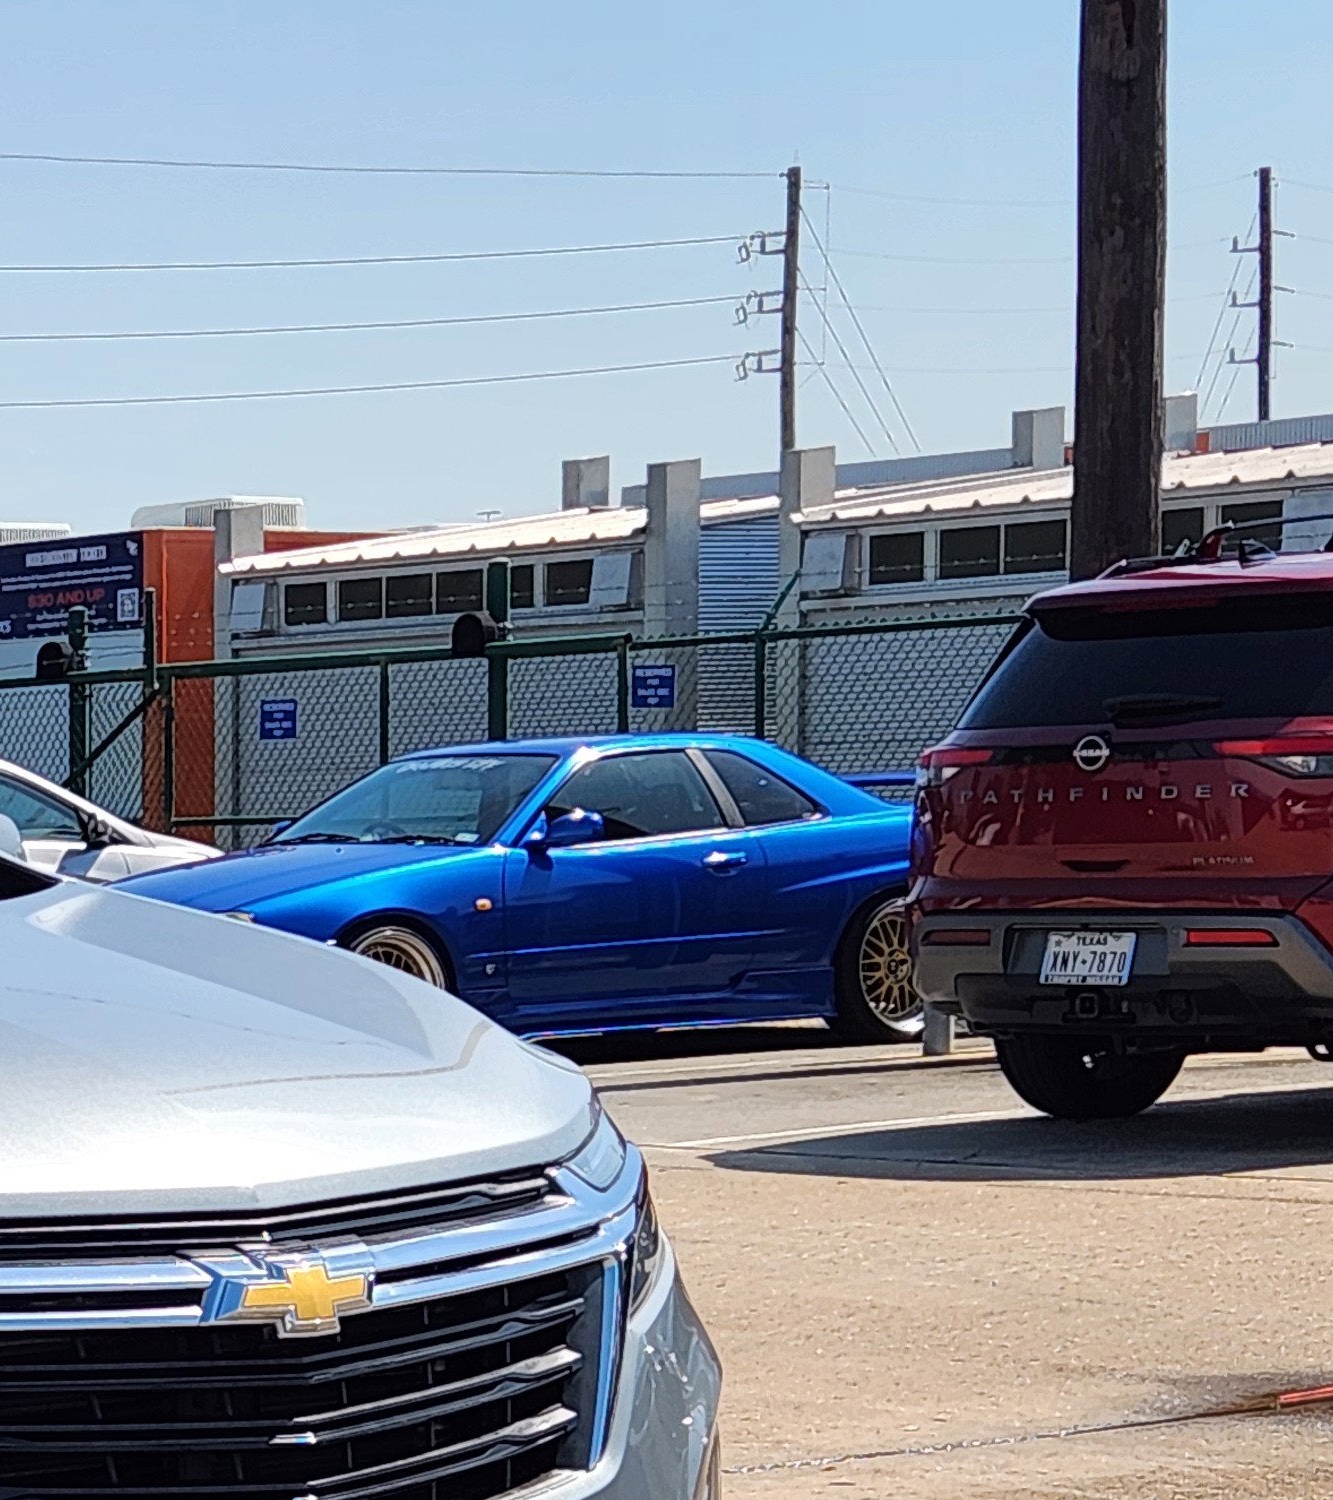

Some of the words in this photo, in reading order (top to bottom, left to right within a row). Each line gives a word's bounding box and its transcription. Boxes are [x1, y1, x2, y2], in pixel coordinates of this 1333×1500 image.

[55, 592, 85, 606] AND
[86, 588, 106, 602] UP
[960, 783, 1251, 804] PATHFINDER
[1076, 935, 1108, 946] TEXAS
